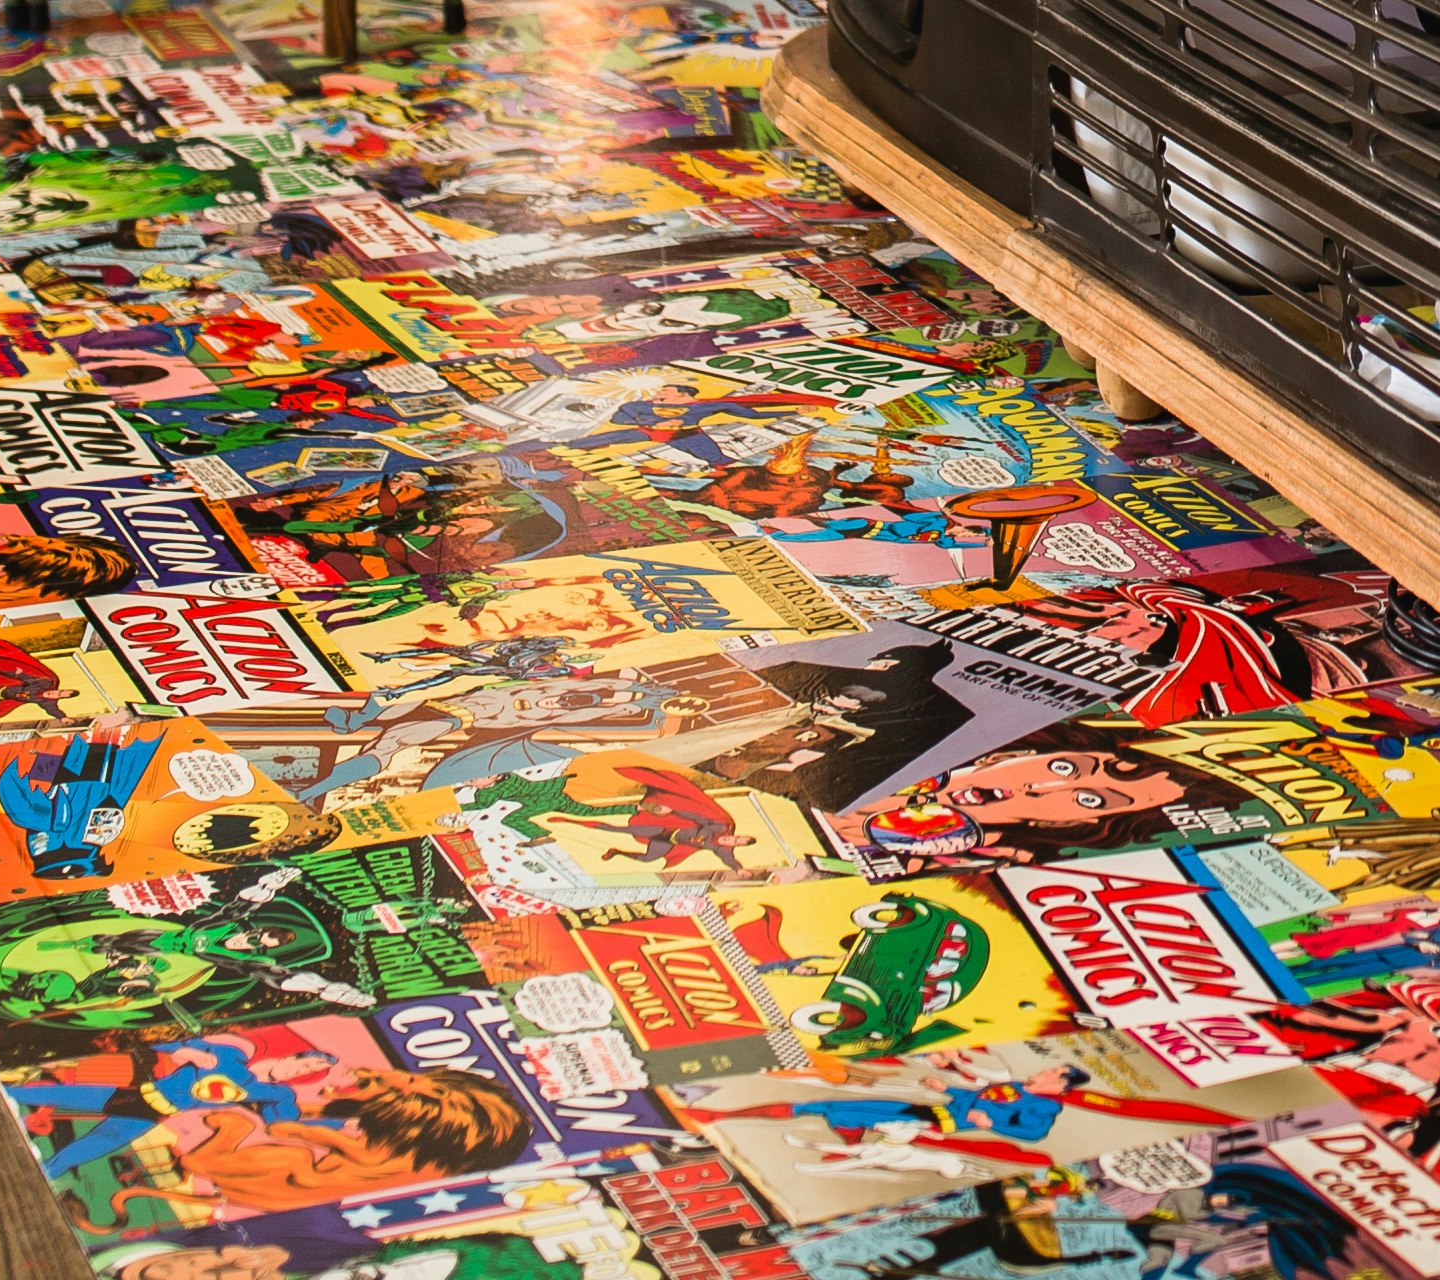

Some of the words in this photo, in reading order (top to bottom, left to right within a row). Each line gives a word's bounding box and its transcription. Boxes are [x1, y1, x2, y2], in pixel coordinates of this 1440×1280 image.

[343, 202, 418, 257] Detective
[363, 274, 538, 350] FLASH
[705, 353, 879, 401] OMICS
[763, 340, 957, 385] TION
[10, 387, 170, 473] ACTION
[922, 385, 1090, 485] AQUAMAN
[72, 483, 248, 576] ACTION
[1106, 472, 1278, 538] ACTION
[1112, 492, 1192, 540] COMICS
[584, 552, 746, 631] ACTION
[602, 568, 686, 634] COMICS
[701, 538, 862, 636] ANNIVERSARY
[107, 604, 229, 704] COMICS
[135, 592, 328, 696] ACTION
[1006, 628, 1167, 690] KNIGHT
[951, 671, 987, 686] PART
[987, 681, 1020, 696] ONE
[1021, 692, 1044, 704] OF
[1043, 698, 1082, 714] FIVE
[963, 660, 1109, 708] GRIMM
[1129, 719, 1368, 825] ACTION
[1197, 806, 1242, 835] LONG
[289, 849, 384, 908] ANTERN
[364, 846, 416, 897] GREEN
[371, 934, 474, 1000] ARROW
[408, 927, 483, 977] GREEN
[1025, 883, 1160, 1008] COMICS
[1026, 864, 1280, 1007] ACTION
[590, 927, 782, 1032] ACTION
[607, 960, 676, 1032] COMICS
[1312, 1167, 1412, 1242] COMICS
